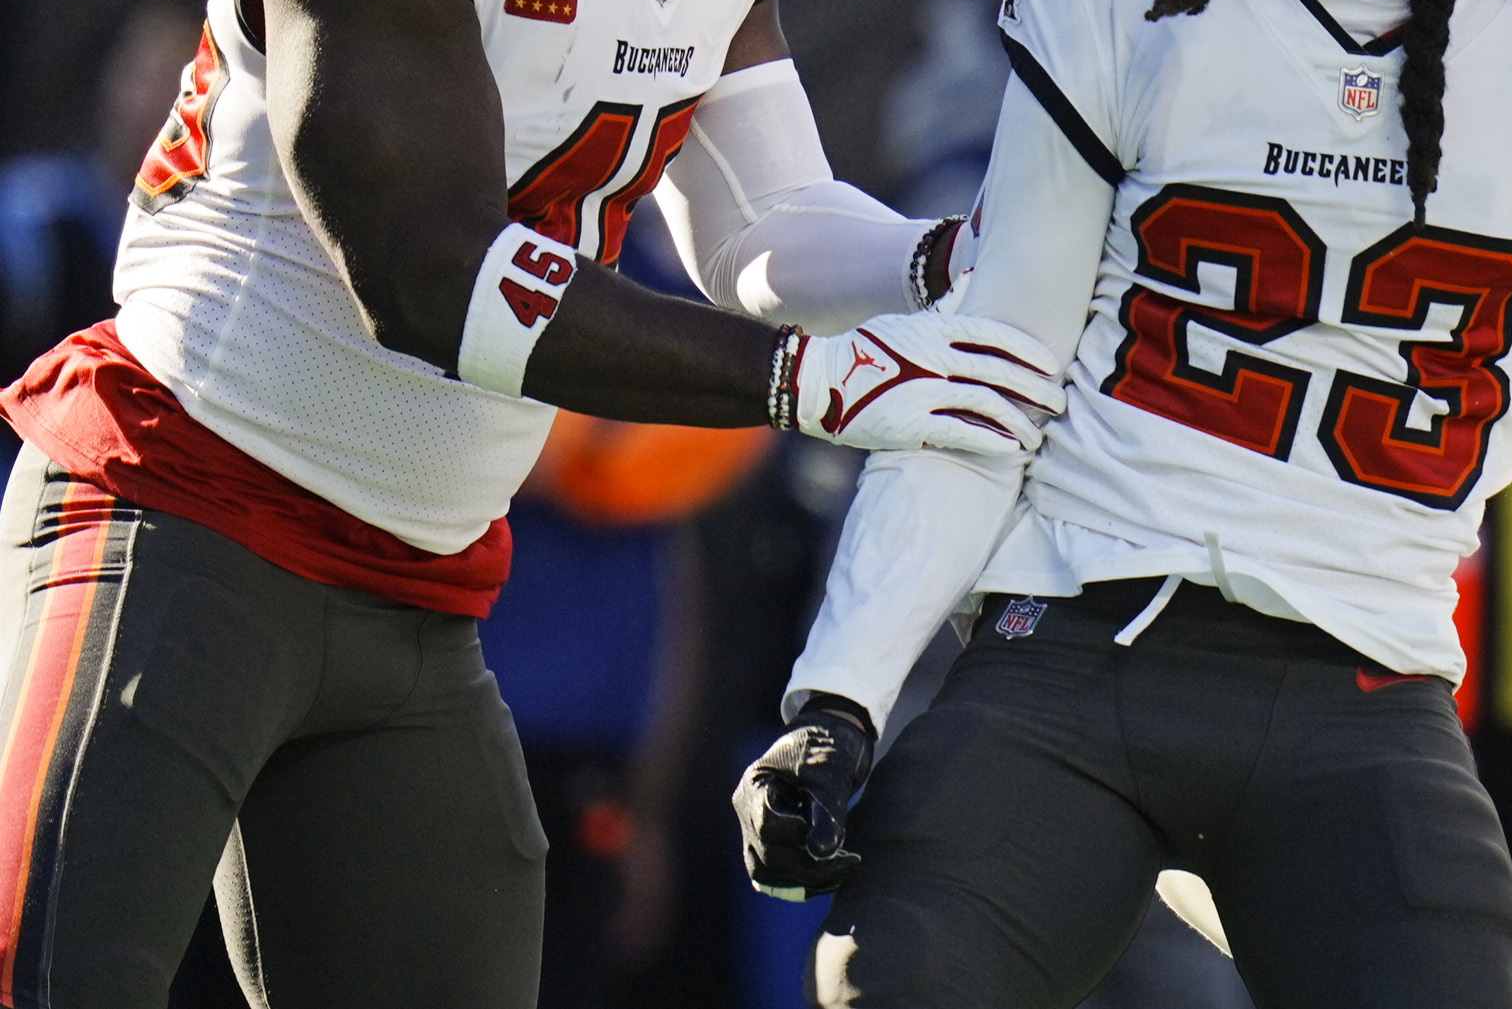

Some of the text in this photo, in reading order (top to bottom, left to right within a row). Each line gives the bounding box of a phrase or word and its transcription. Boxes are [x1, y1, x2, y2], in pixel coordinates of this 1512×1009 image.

[613, 39, 695, 81] BUCCANEERS
[1346, 88, 1374, 110] NFL
[1263, 142, 1410, 187] BUCCANEE
[499, 241, 574, 329] 45
